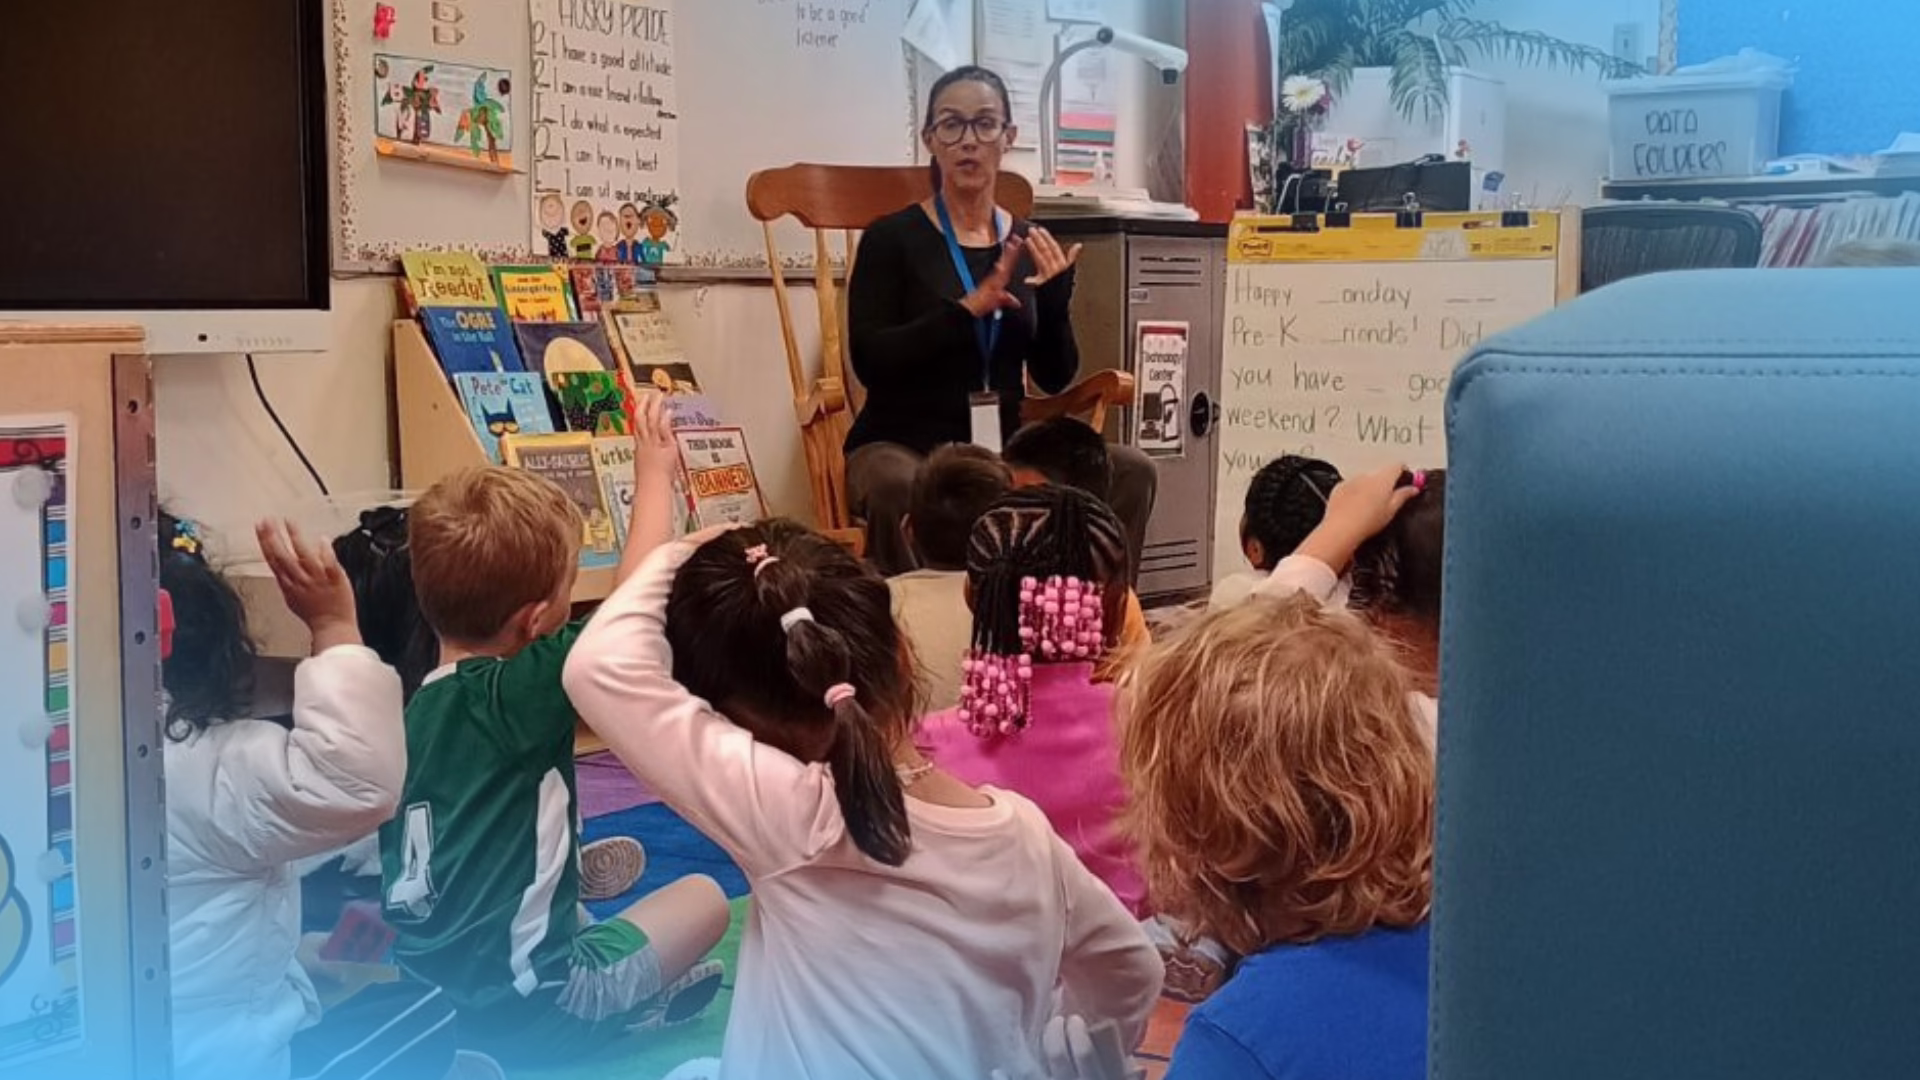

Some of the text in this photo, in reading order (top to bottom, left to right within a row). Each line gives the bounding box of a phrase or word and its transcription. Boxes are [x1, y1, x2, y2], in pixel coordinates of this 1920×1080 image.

[558, 0, 669, 46] HUSKY PRIDE
[600, 46, 625, 70] good
[570, 107, 584, 131] do
[1645, 109, 1698, 136] DATA
[576, 150, 594, 163] can
[635, 148, 658, 172] best
[1633, 141, 1727, 175] FOLDERS
[576, 185, 594, 198] can
[421, 259, 473, 278] I'm not
[417, 277, 487, 302] Ready!
[1234, 268, 1292, 308] Happy
[1232, 315, 1300, 347] Pre-K
[1440, 317, 1482, 351] Did
[470, 376, 535, 396] Pete Cat
[1149, 368, 1176, 382] Center
[1231, 361, 1448, 402] you have goo
[1357, 410, 1434, 446] What
[686, 436, 735, 451] THIS BOOK
[1222, 447, 1263, 476] you
[698, 466, 748, 494] BANNED
